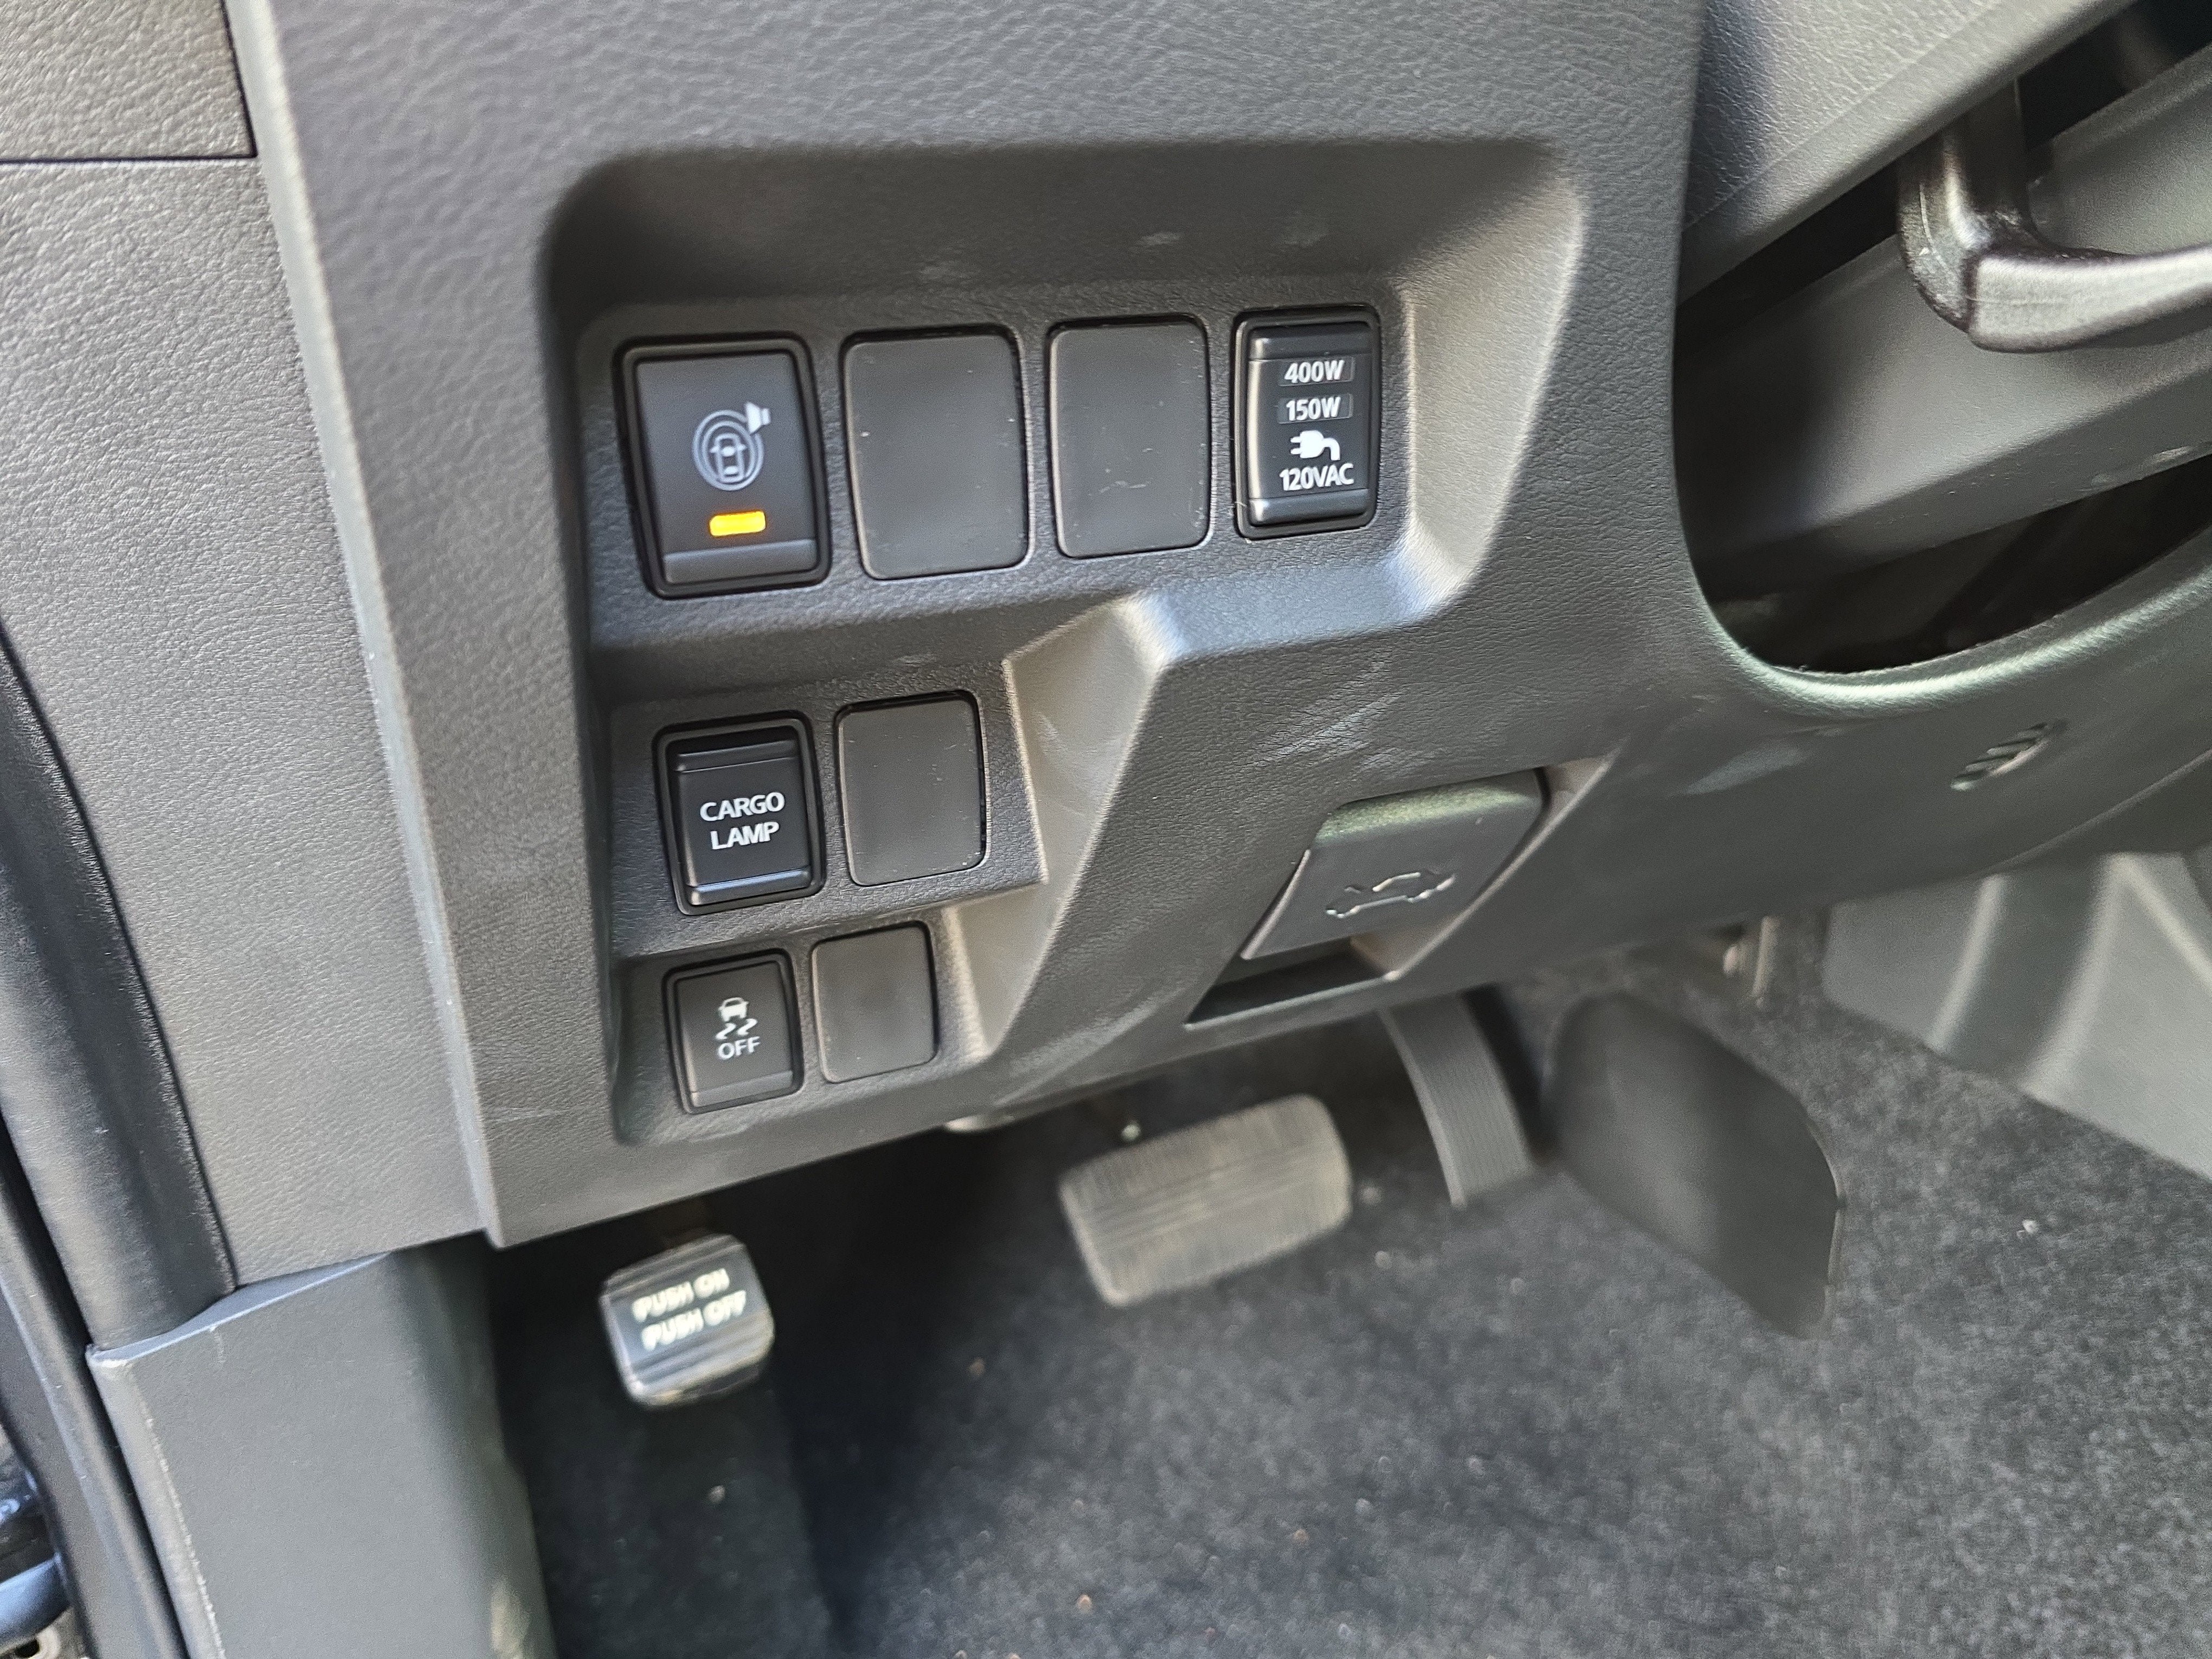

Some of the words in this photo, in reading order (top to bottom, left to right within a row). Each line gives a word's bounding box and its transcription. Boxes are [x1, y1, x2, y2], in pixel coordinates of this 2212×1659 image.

[1284, 360, 1345, 384] 400W
[1285, 396, 1341, 421] 150W
[1279, 462, 1354, 491] 120VAC
[700, 792, 785, 821] CARGO
[710, 821, 780, 850] LAMP
[718, 1036, 760, 1059] OFF
[632, 1282, 693, 1323] PUSH
[693, 1268, 730, 1299] ON
[641, 1307, 704, 1351] PUSH
[704, 1289, 746, 1326] OFF
